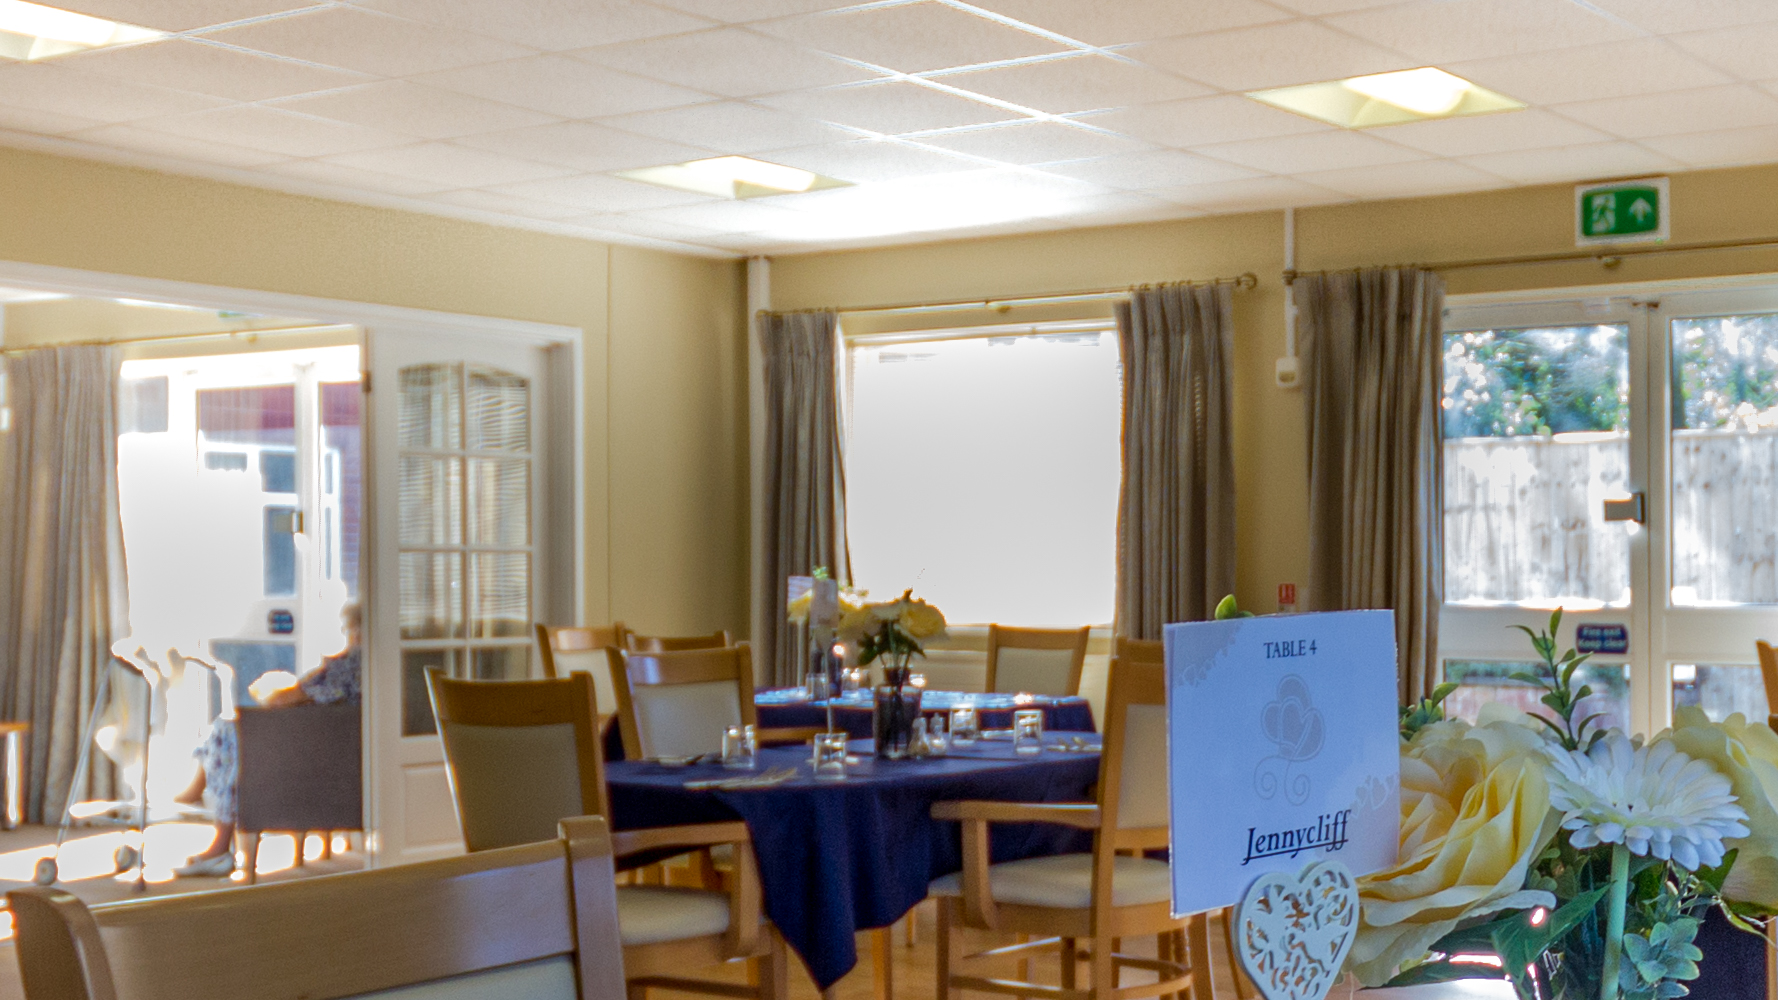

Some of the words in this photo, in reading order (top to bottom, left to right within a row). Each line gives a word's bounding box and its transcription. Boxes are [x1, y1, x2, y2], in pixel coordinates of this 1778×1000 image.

[1263, 639, 1307, 659] TABLE
[1309, 639, 1317, 655] 4
[1240, 808, 1352, 866] Jennycliff
